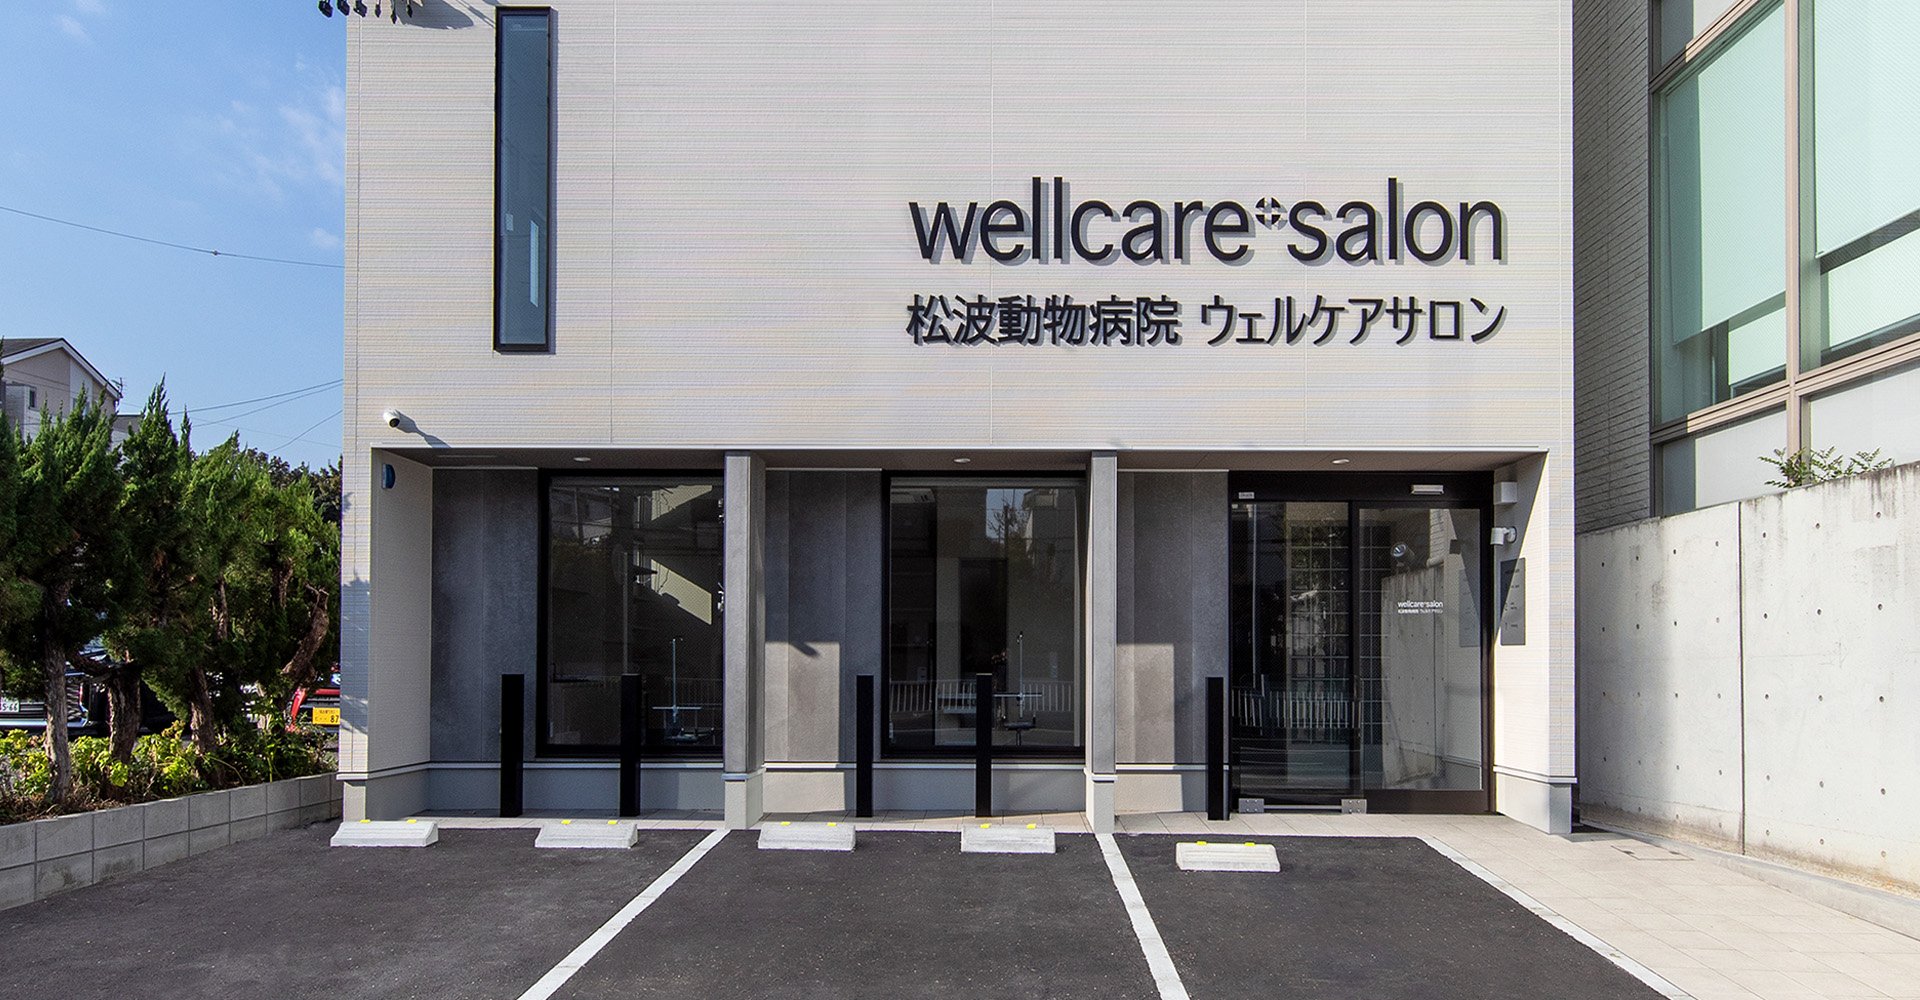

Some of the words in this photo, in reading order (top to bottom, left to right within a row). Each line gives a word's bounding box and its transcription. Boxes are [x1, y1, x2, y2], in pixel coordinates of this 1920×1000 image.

[908, 177, 1251, 262] wellcare
[1286, 177, 1502, 262] salon
[906, 295, 1180, 345] 松波動物病院
[1201, 295, 1505, 345] ウェルケアサロン
